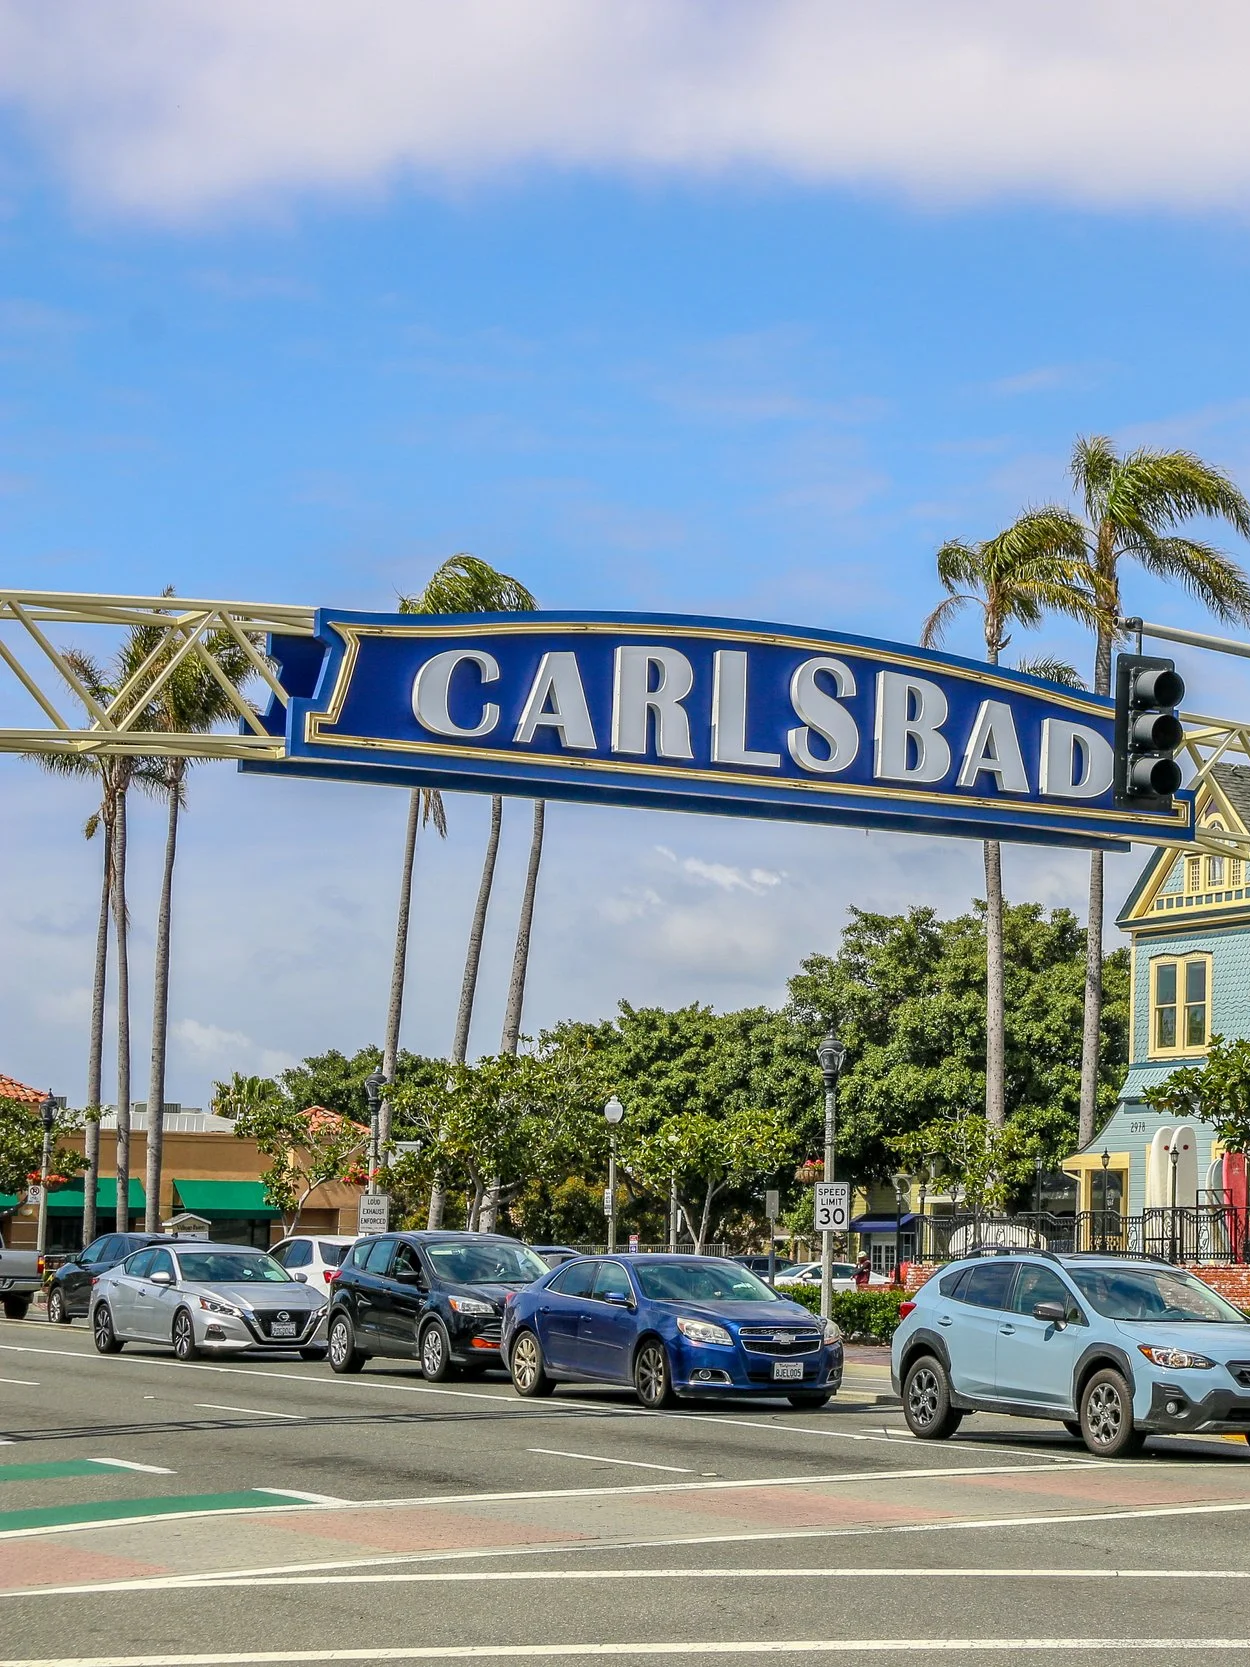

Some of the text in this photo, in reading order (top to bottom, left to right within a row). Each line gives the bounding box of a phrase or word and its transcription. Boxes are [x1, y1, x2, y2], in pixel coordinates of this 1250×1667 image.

[411, 644, 1115, 799] CARLSBAD
[1130, 1121, 1146, 1133] 2978
[818, 1188, 846, 1196] SPEED
[821, 1198, 843, 1206] LIMIT
[361, 1217, 386, 1225] ENFORCED
[819, 1207, 845, 1225] 30
